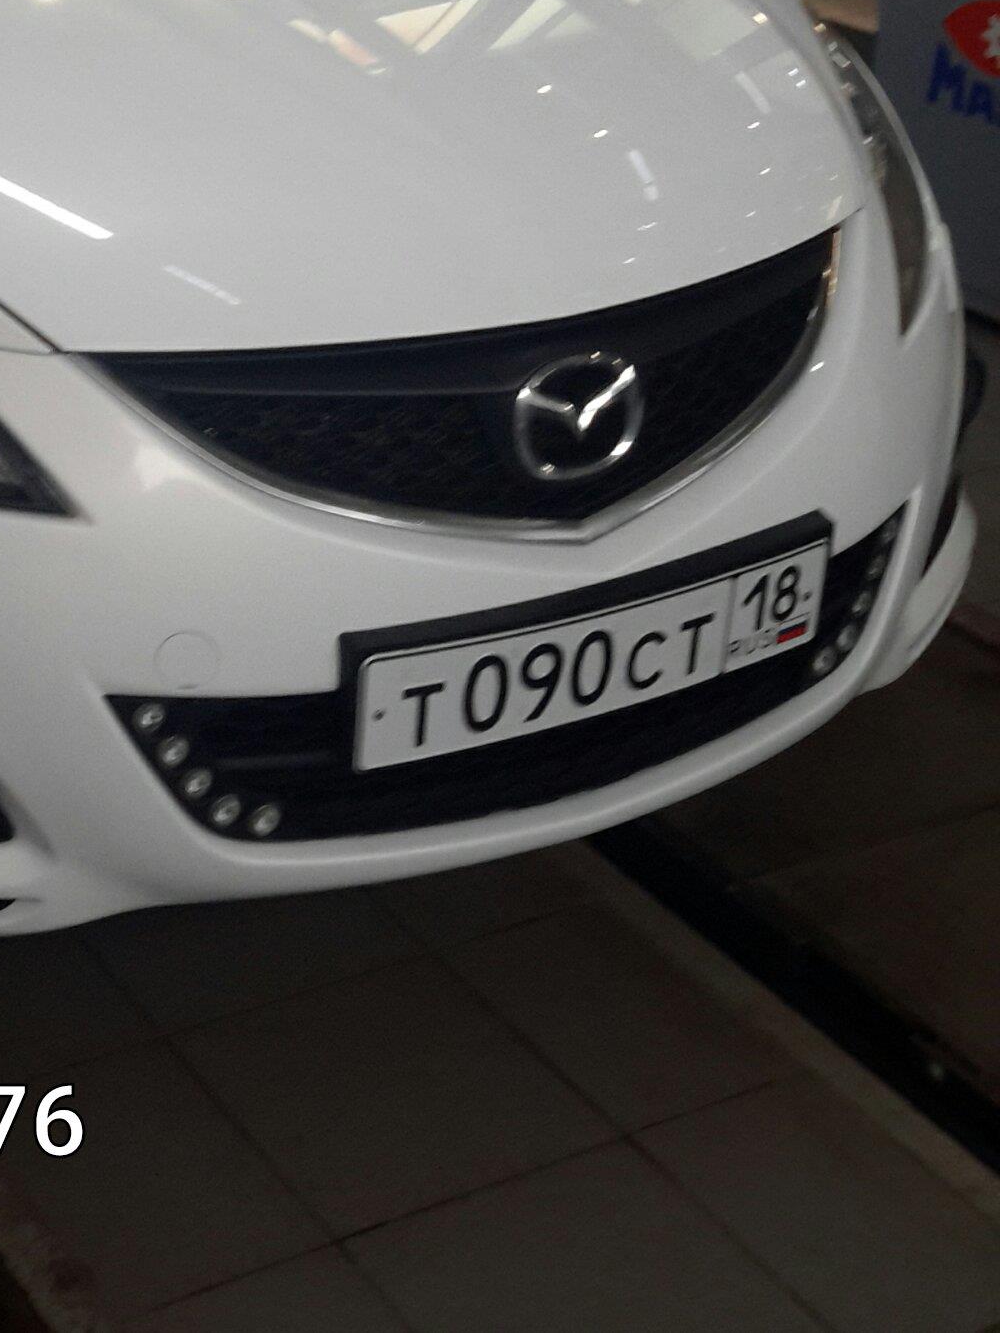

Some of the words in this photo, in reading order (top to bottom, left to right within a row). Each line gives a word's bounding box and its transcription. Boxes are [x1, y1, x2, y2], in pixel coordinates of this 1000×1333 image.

[927, 43, 1000, 128] MA
[402, 612, 716, 748] Т090СТ
[743, 565, 799, 631] 18
